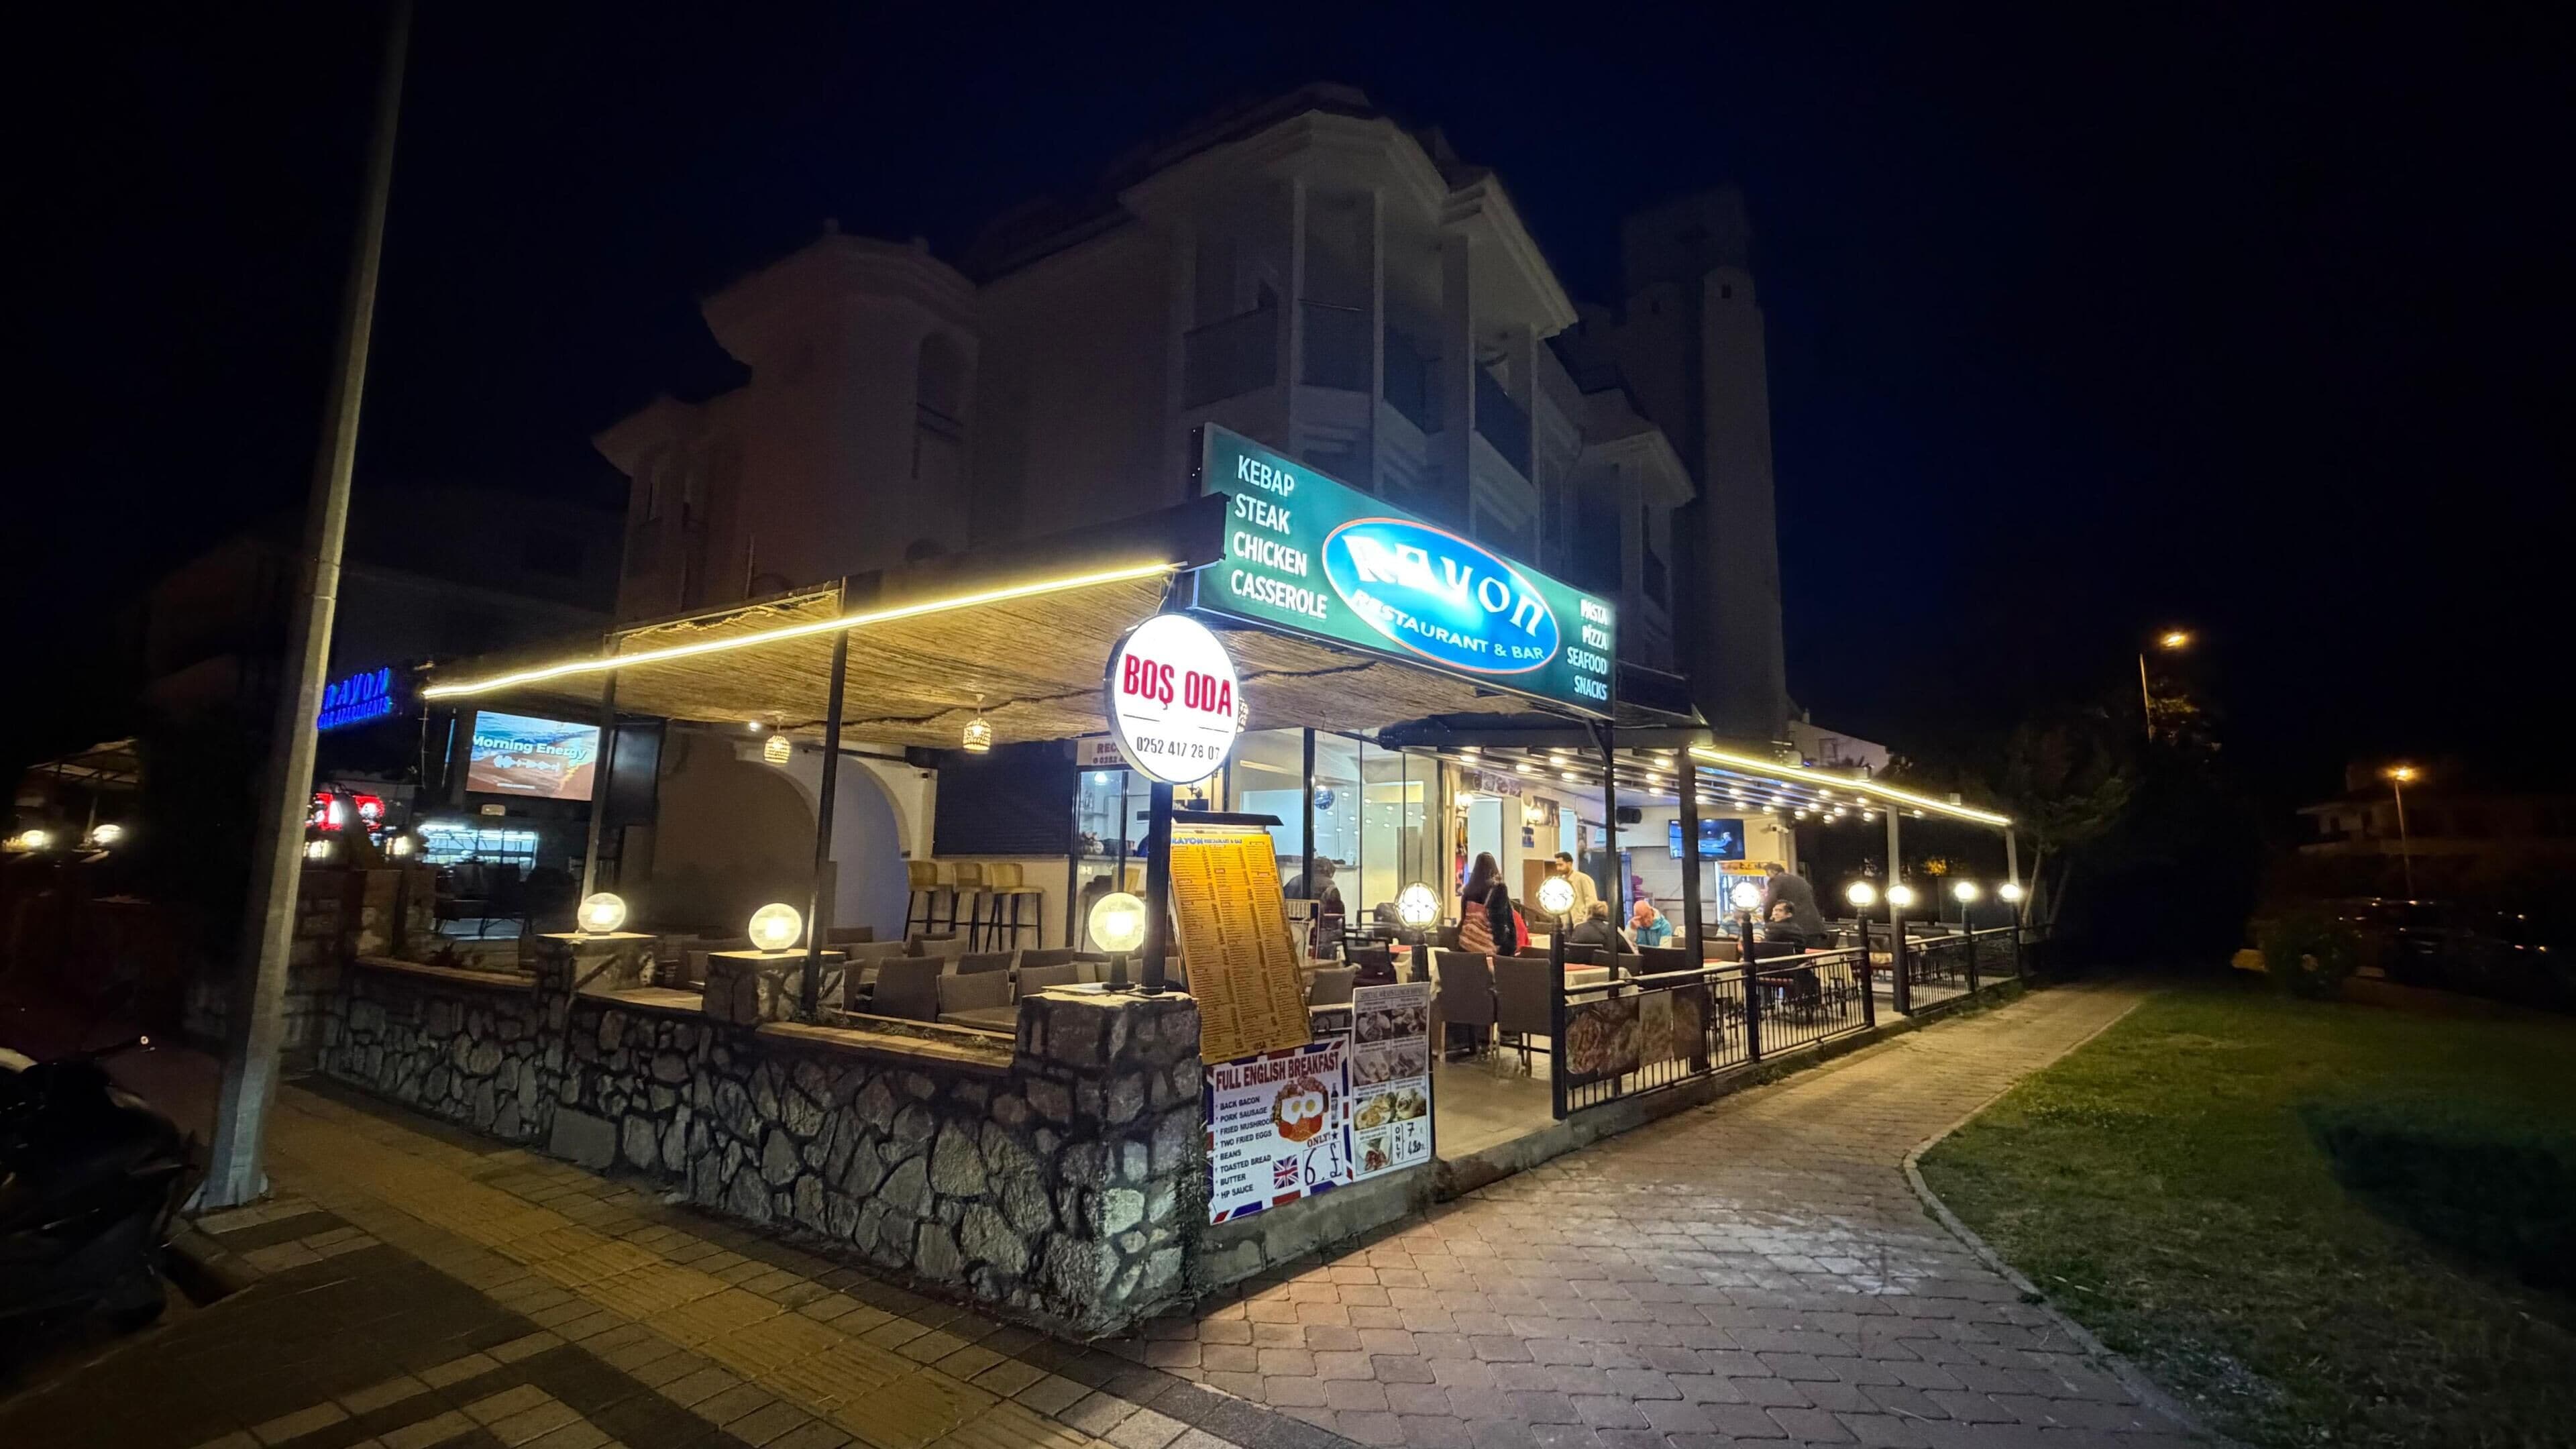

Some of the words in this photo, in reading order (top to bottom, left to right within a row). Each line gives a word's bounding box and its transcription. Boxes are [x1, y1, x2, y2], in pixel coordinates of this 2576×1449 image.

[1237, 455, 1295, 497] KEBAP
[1234, 493, 1291, 535] STEAK
[1233, 531, 1307, 577] CHICKEN
[1231, 569, 1328, 619] CASSEROLE
[1580, 598, 1608, 625] PASTA
[1350, 589, 1489, 653] RESTAURANT
[1494, 643, 1507, 657] &
[1512, 647, 1545, 660] BAR
[1567, 646, 1607, 675] SEAFOOD
[324, 667, 390, 710] RAYON
[1123, 653, 1174, 710] BOŞ
[1185, 671, 1232, 717] ODA
[1574, 675, 1607, 701] SNACKS
[473, 735, 533, 754] Morning
[537, 743, 587, 760] Energy
[1097, 743, 1117, 753] REC
[1136, 737, 1164, 754] 0252
[1168, 741, 1187, 757] 417
[1191, 744, 1203, 758] 28
[1208, 746, 1220, 760] 07
[1216, 1068, 1241, 1092] FULL
[1244, 1061, 1286, 1087] ENGLISH
[1288, 1051, 1339, 1079] BREAKFAST
[1220, 1100, 1237, 1110] BACK
[1239, 1095, 1260, 1106] BACON
[1220, 1113, 1238, 1123] PORK
[1239, 1106, 1268, 1118] SAUSAGE
[1220, 1126, 1238, 1136] FRIED
[1240, 1117, 1274, 1130] MUSHROO
[1220, 1138, 1234, 1148] TWO
[1236, 1134, 1254, 1144] FRIED
[1256, 1130, 1272, 1140] EGGS
[1407, 1122, 1414, 1136] 7
[1220, 1149, 1241, 1160] BEANS
[1220, 1160, 1249, 1173] TOASTED
[1250, 1155, 1271, 1166] BREAD
[1220, 1173, 1246, 1185] BUTTER
[1221, 1190, 1232, 1199] HP
[1232, 1184, 1254, 1196] SAUCE
